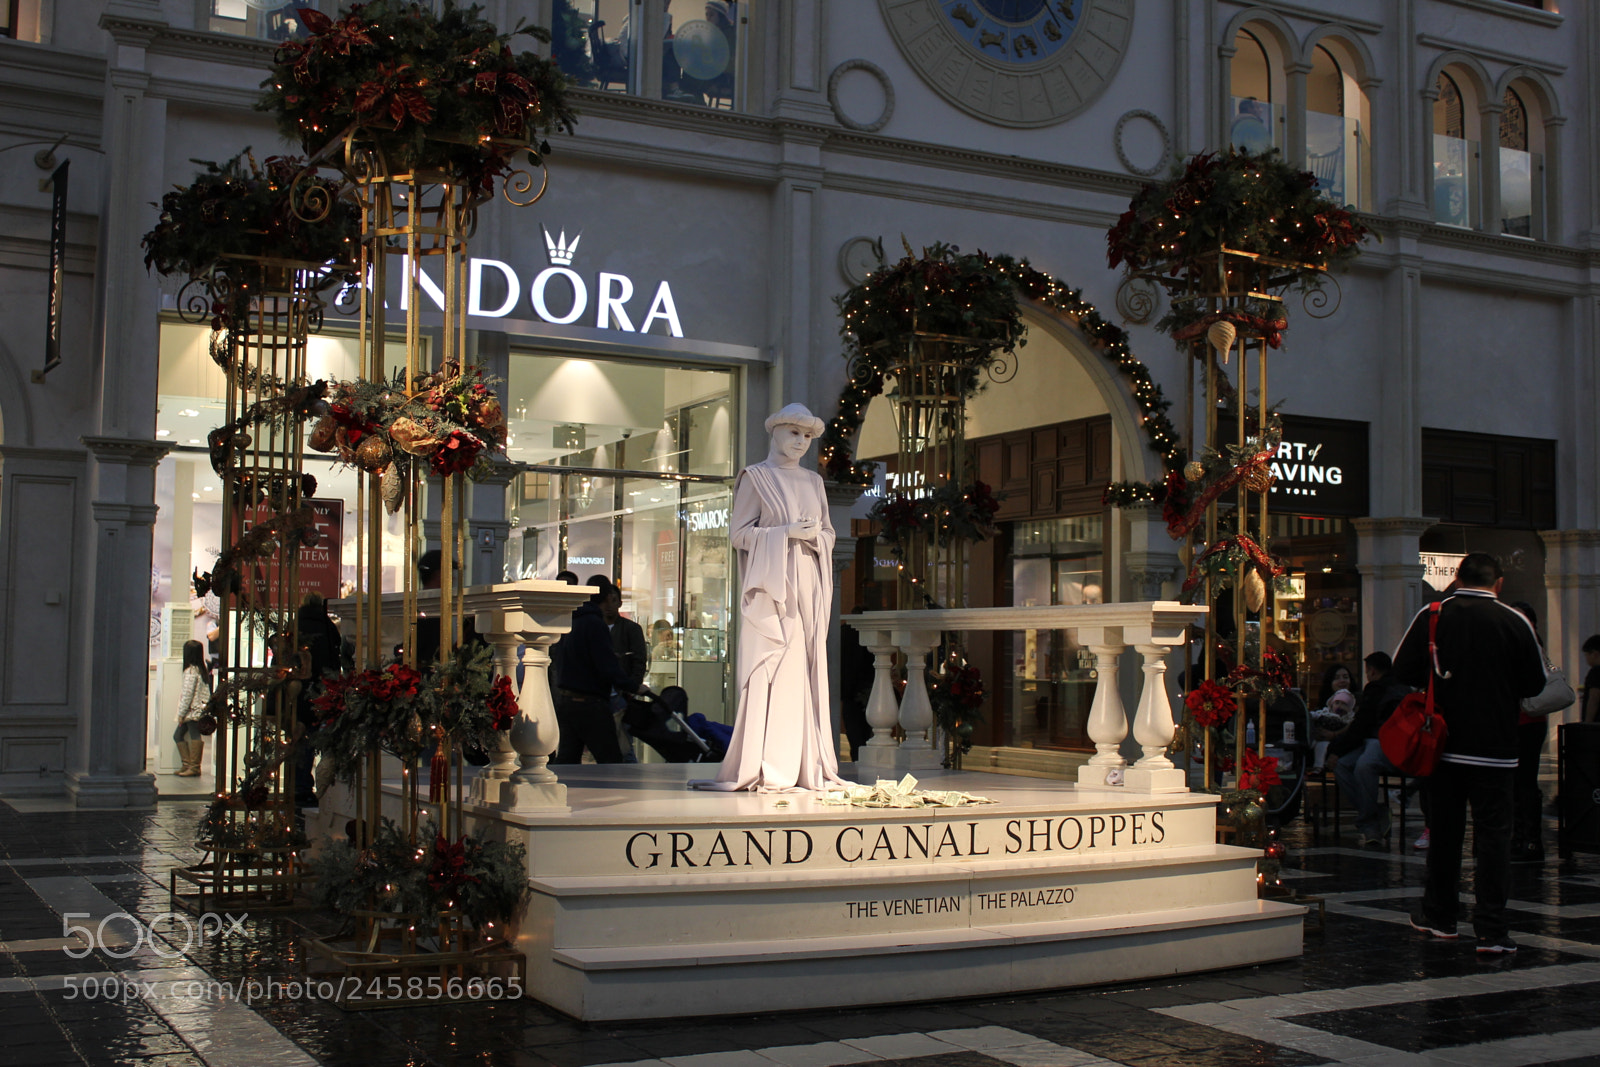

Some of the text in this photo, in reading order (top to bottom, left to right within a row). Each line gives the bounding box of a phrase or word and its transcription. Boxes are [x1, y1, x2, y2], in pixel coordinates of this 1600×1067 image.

[295, 253, 684, 338] NDORA
[1268, 462, 1343, 485] AVING
[1285, 487, 1317, 496] YORK
[243, 520, 330, 550] FE
[299, 550, 329, 561] ITEM
[567, 556, 605, 565] SWAROVSKI
[1434, 566, 1448, 576] THE
[625, 811, 1165, 869] GRAND CANAL SHOPPES
[846, 901, 878, 919] THE
[883, 896, 961, 916] VENETIAN
[978, 893, 1006, 910] THE
